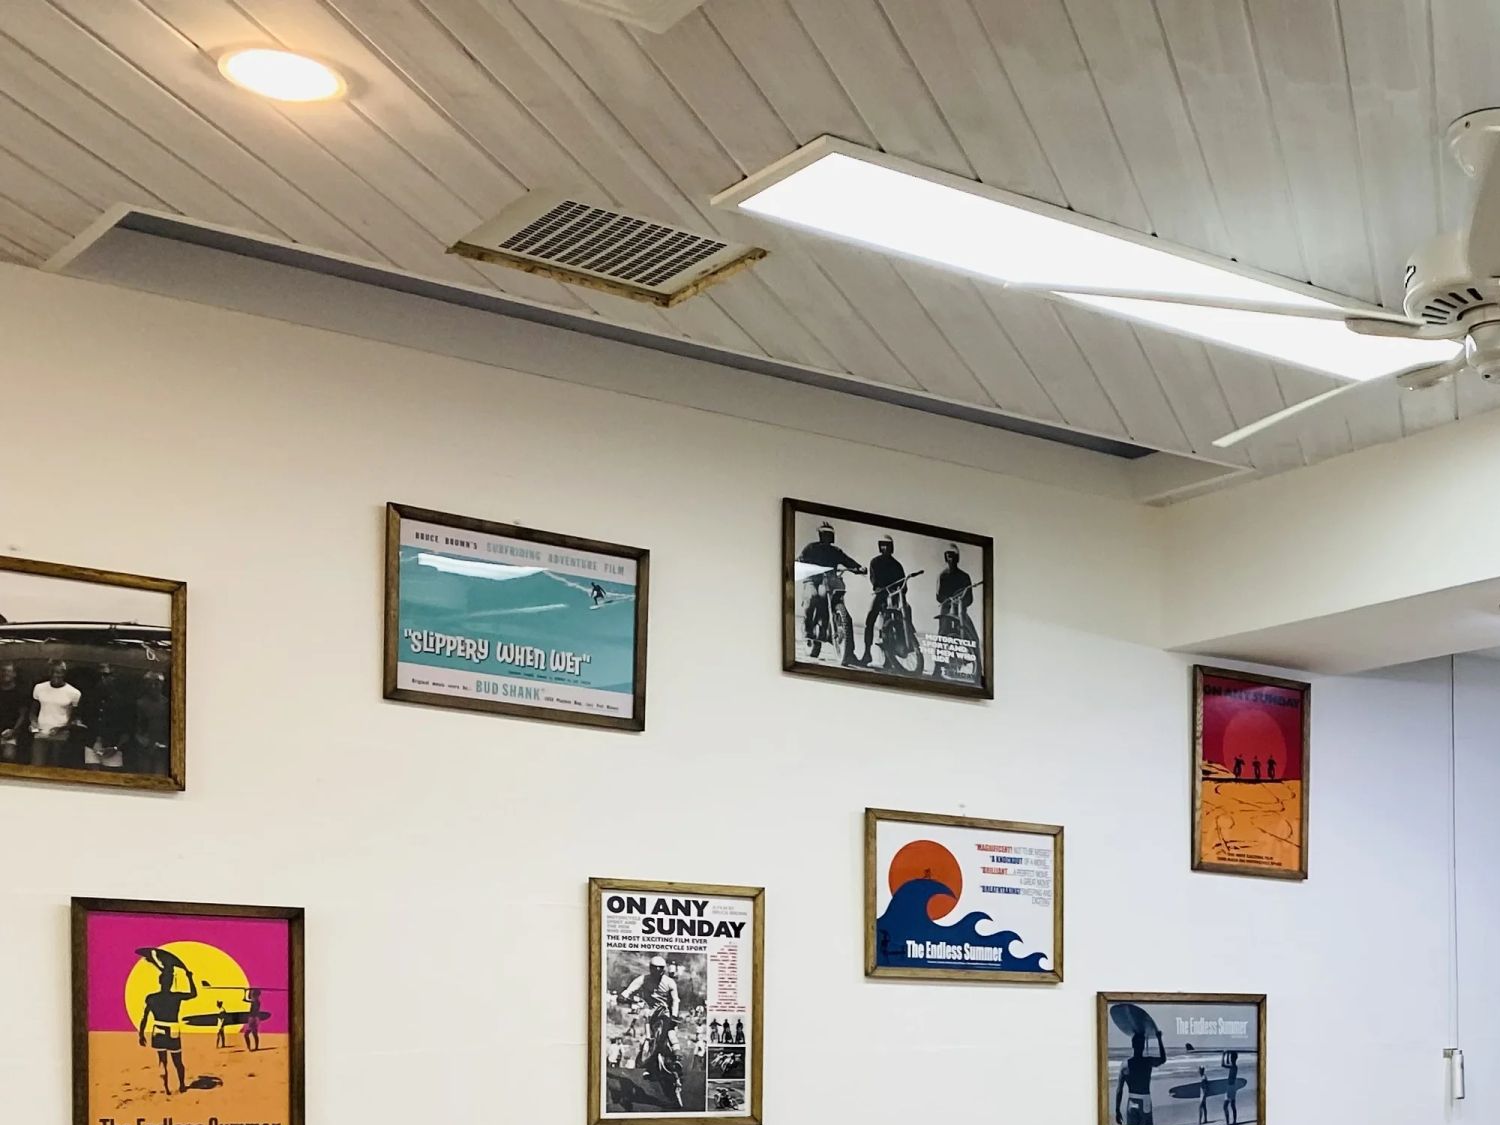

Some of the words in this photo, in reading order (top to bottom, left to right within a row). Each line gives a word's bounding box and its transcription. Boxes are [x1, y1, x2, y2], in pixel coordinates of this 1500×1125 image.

[604, 563, 625, 576] FILM
[475, 680, 499, 695] BUD
[606, 895, 647, 915] ON
[651, 898, 709, 917] ANY
[641, 917, 746, 938] SUNDAY
[642, 936, 673, 944] EXCITING
[906, 940, 924, 959] The
[926, 941, 962, 960] Endless
[964, 943, 1003, 961] Summer
[1176, 1017, 1188, 1035] The
